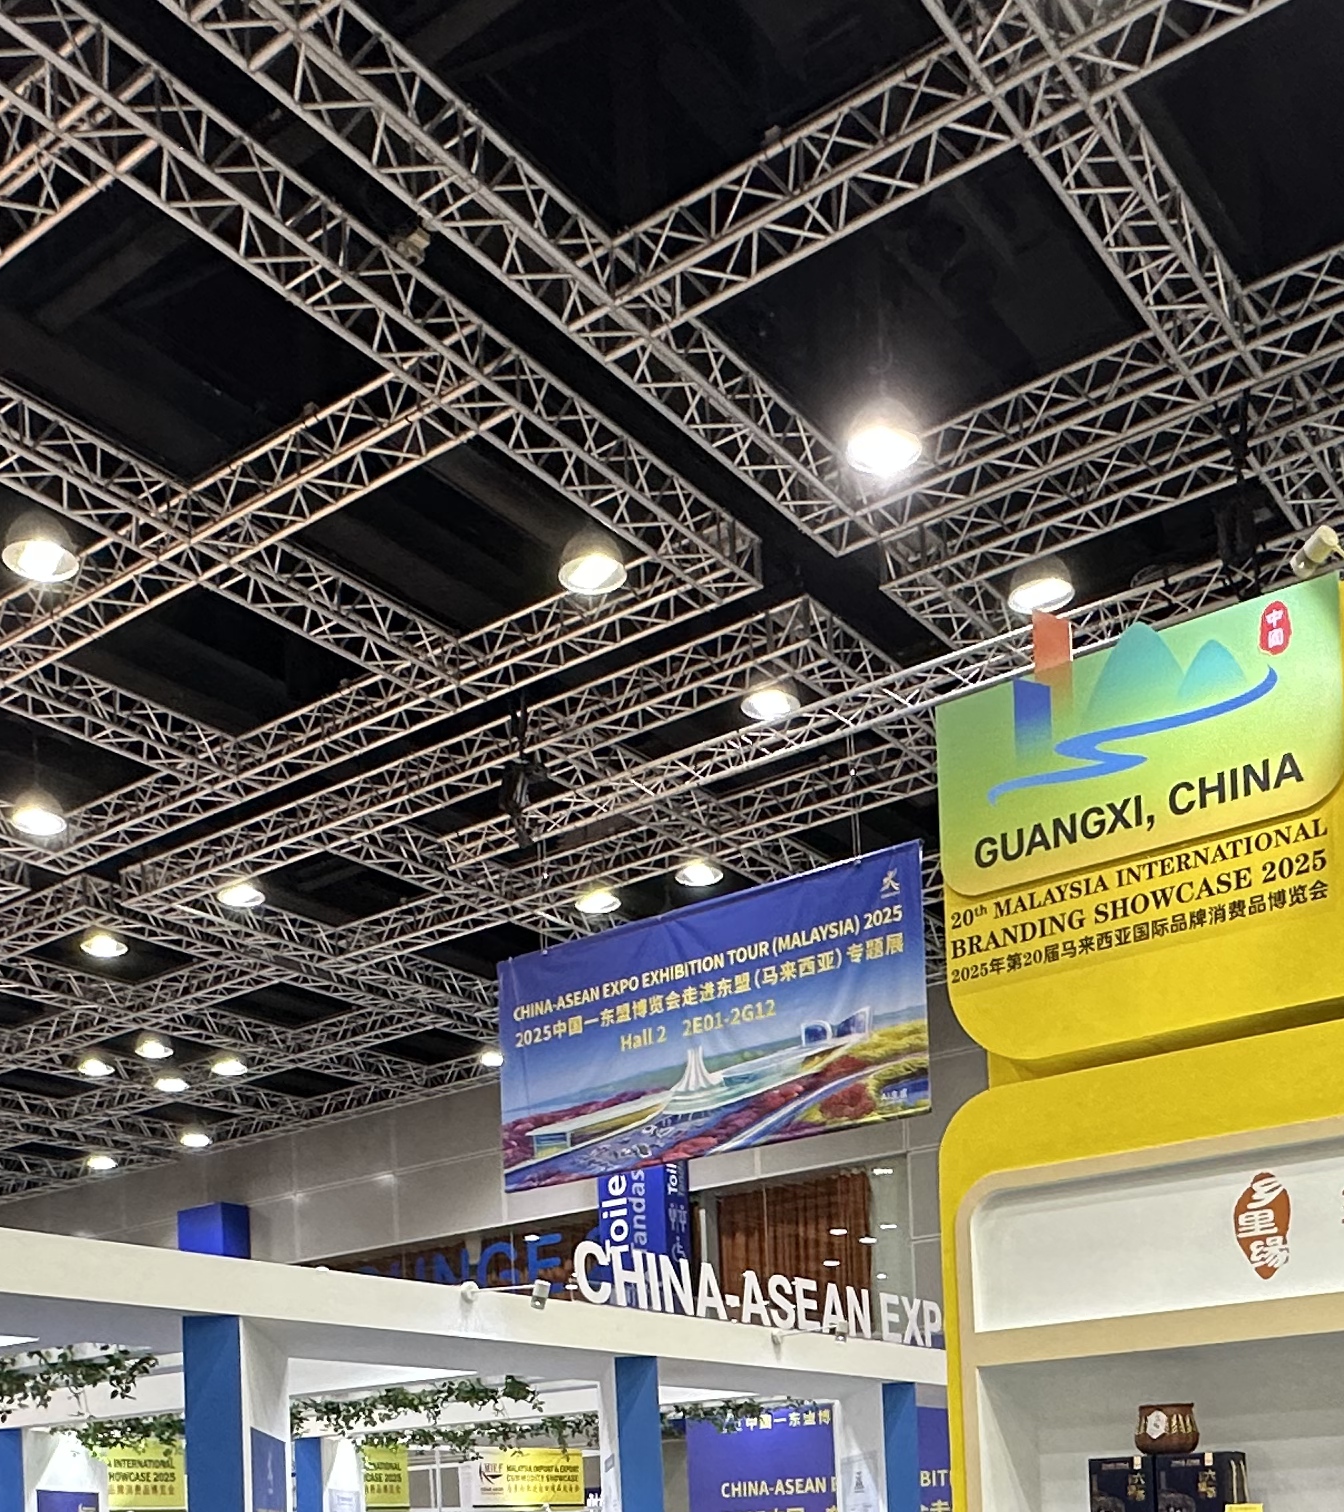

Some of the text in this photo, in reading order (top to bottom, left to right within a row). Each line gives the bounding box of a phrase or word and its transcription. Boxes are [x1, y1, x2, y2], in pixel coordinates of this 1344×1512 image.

[974, 752, 1305, 869] GUANGXI, CHINA
[951, 818, 1328, 930] 20th MALAYSIA INTERNATIONAL
[951, 849, 1327, 960] BRANDING SHOWCASE 2025
[513, 904, 903, 1023] CHINA-ASEAN EXPO EXHIBITION TOUR (MALAYSIA) 2025
[951, 880, 1329, 984] 2025年第20届马来西亚国际品牌消费品博览会
[620, 1000, 777, 1053] Hall 2 2E01-2G12
[573, 1239, 872, 1340] CHINA-ASEAN
[721, 1477, 827, 1498] CHINA-ASEAN
